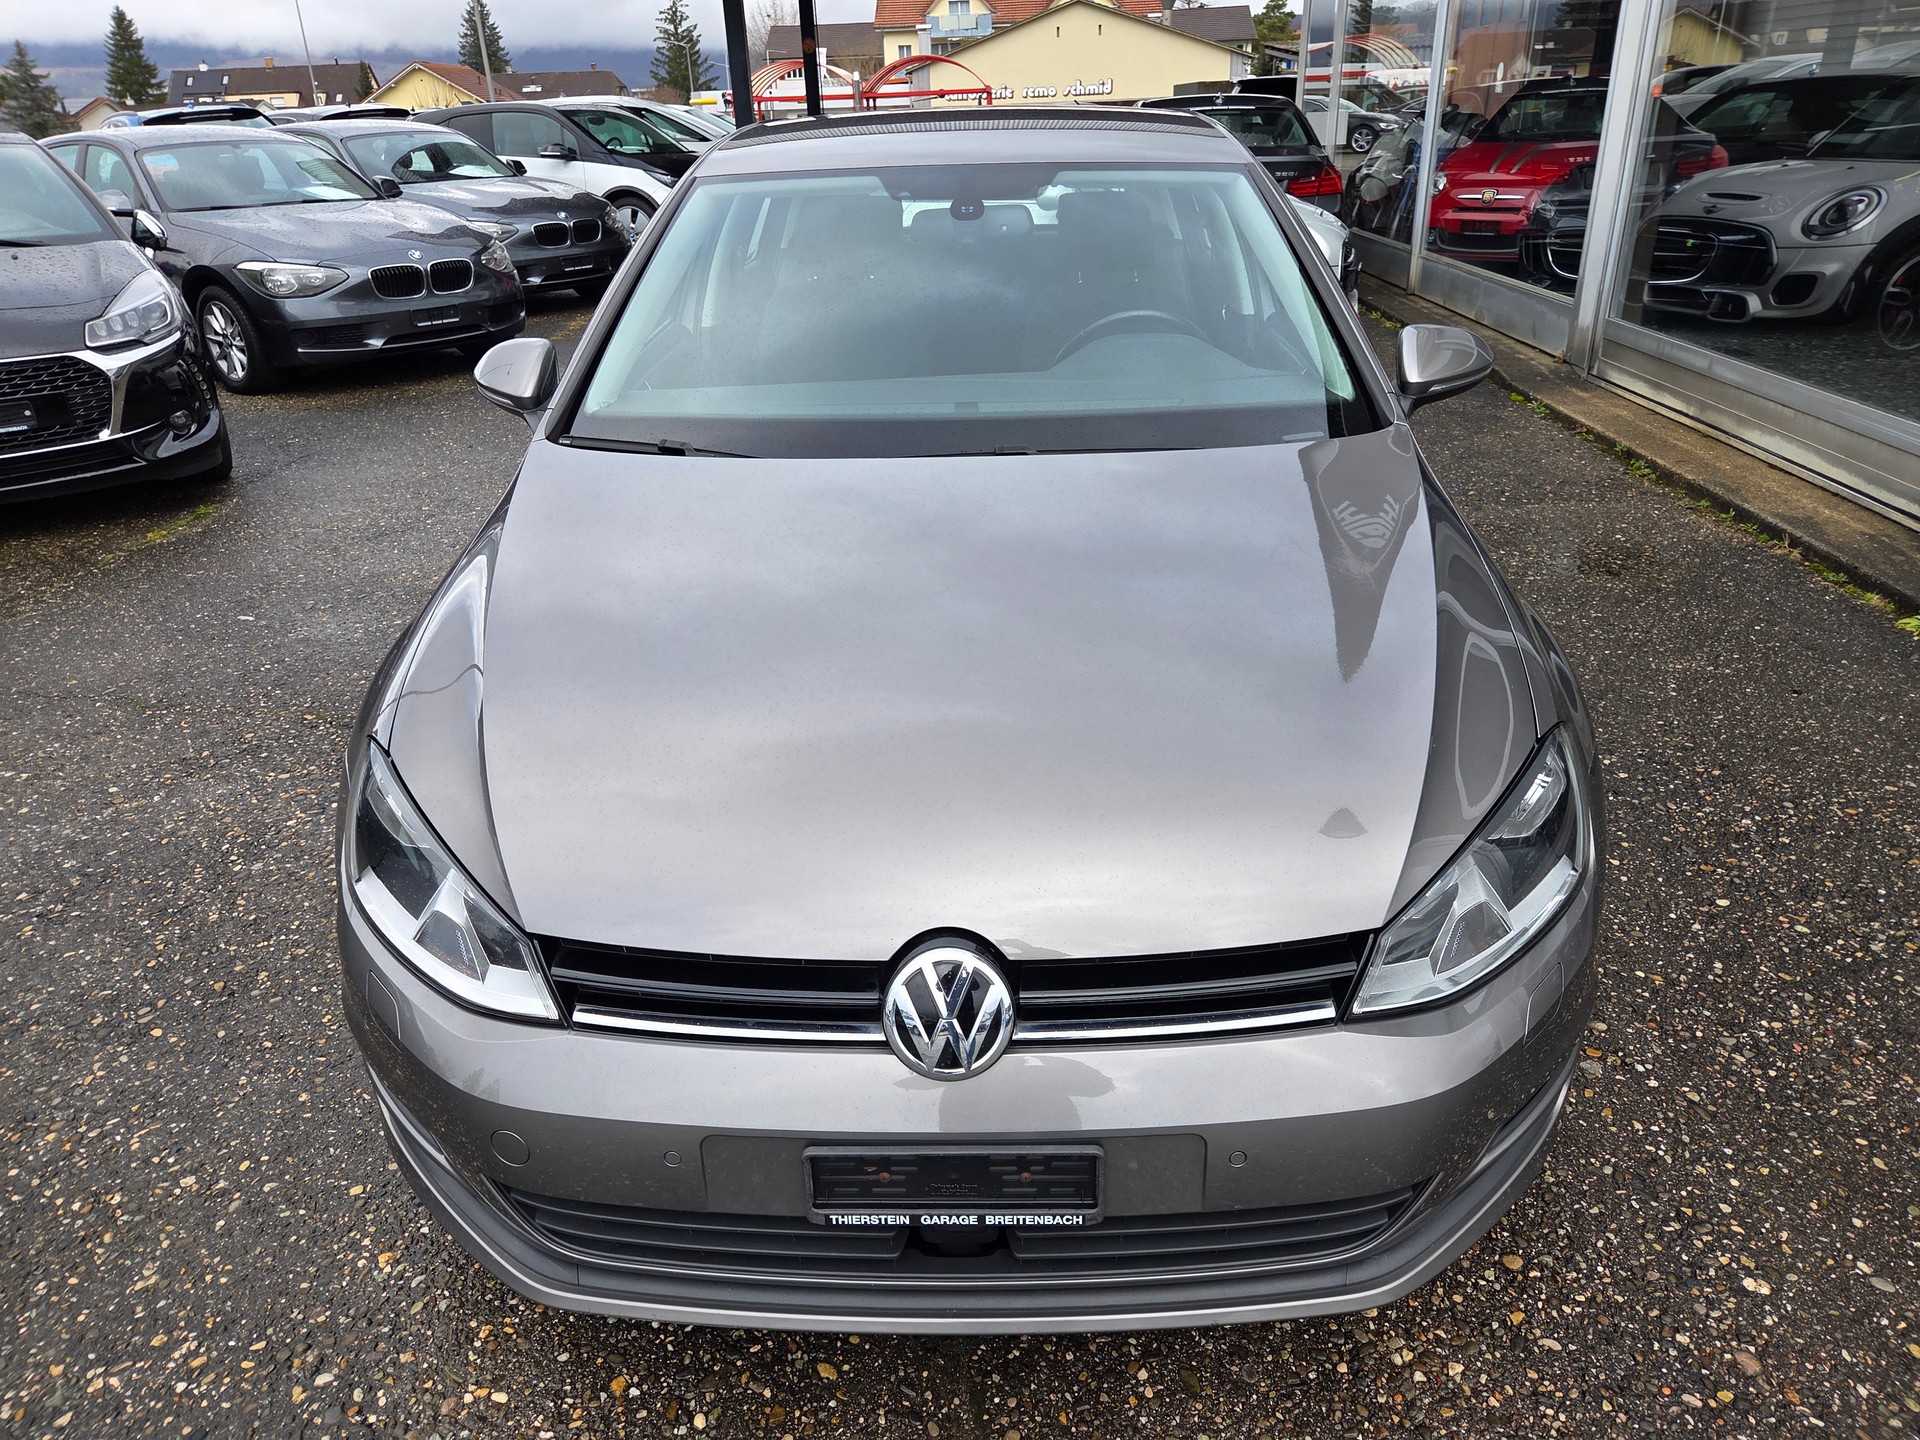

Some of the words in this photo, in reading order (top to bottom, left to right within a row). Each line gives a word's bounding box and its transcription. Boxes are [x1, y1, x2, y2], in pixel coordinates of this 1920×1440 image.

[1021, 86, 1057, 99] remo
[1063, 78, 1113, 98] schmid
[829, 1214, 910, 1225] THIERSTEIN
[920, 1214, 979, 1226] GARAGE
[985, 1214, 1083, 1225] BREITENBACH
